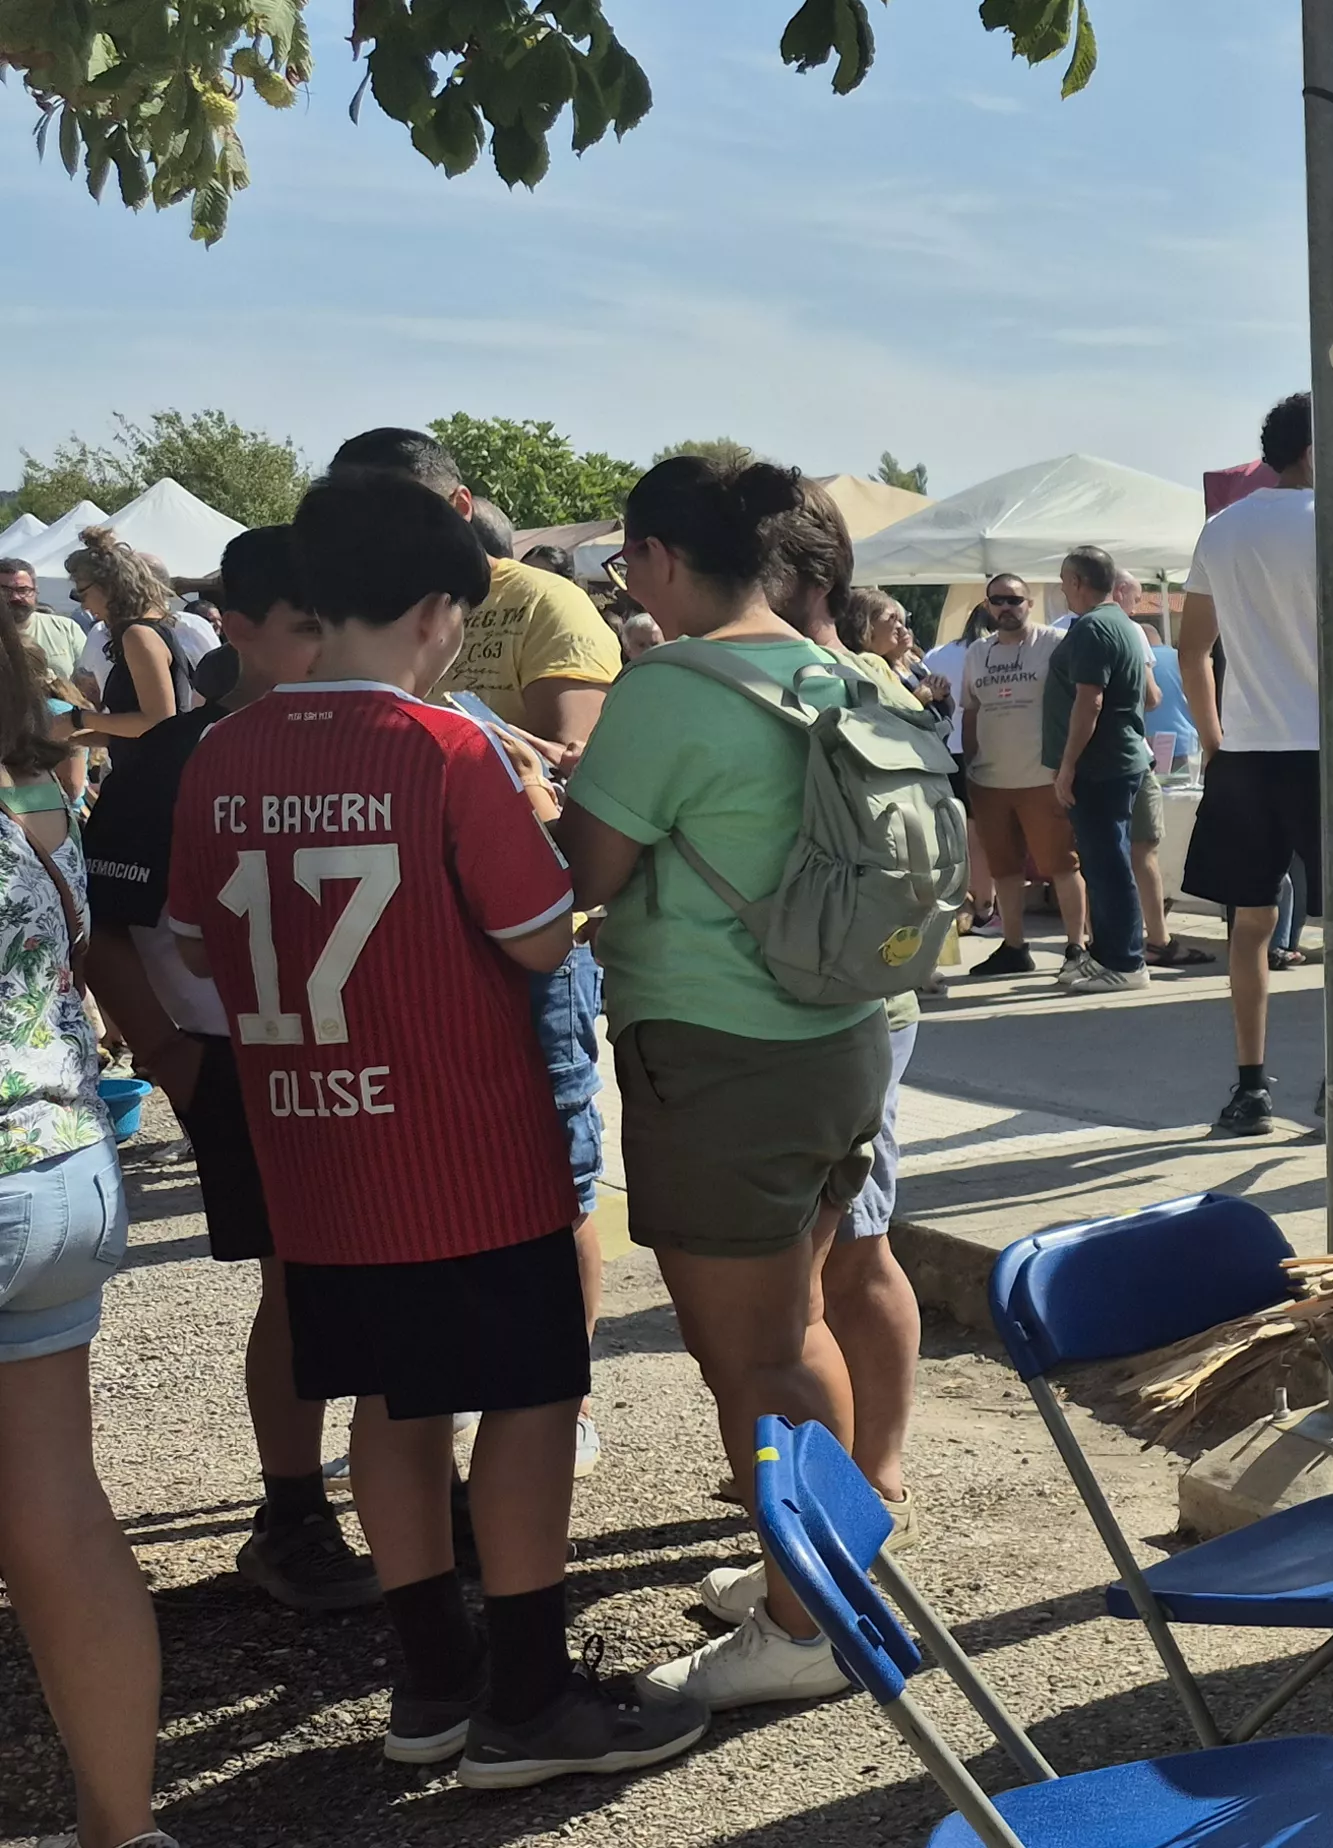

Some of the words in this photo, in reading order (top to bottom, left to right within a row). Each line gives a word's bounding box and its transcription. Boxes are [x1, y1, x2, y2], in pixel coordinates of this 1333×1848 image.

[975, 671, 1038, 689] DENMARK
[213, 795, 247, 834] FC
[262, 792, 392, 834] BAYERN
[216, 843, 402, 1046] 17
[268, 1065, 395, 1118] OLISE
